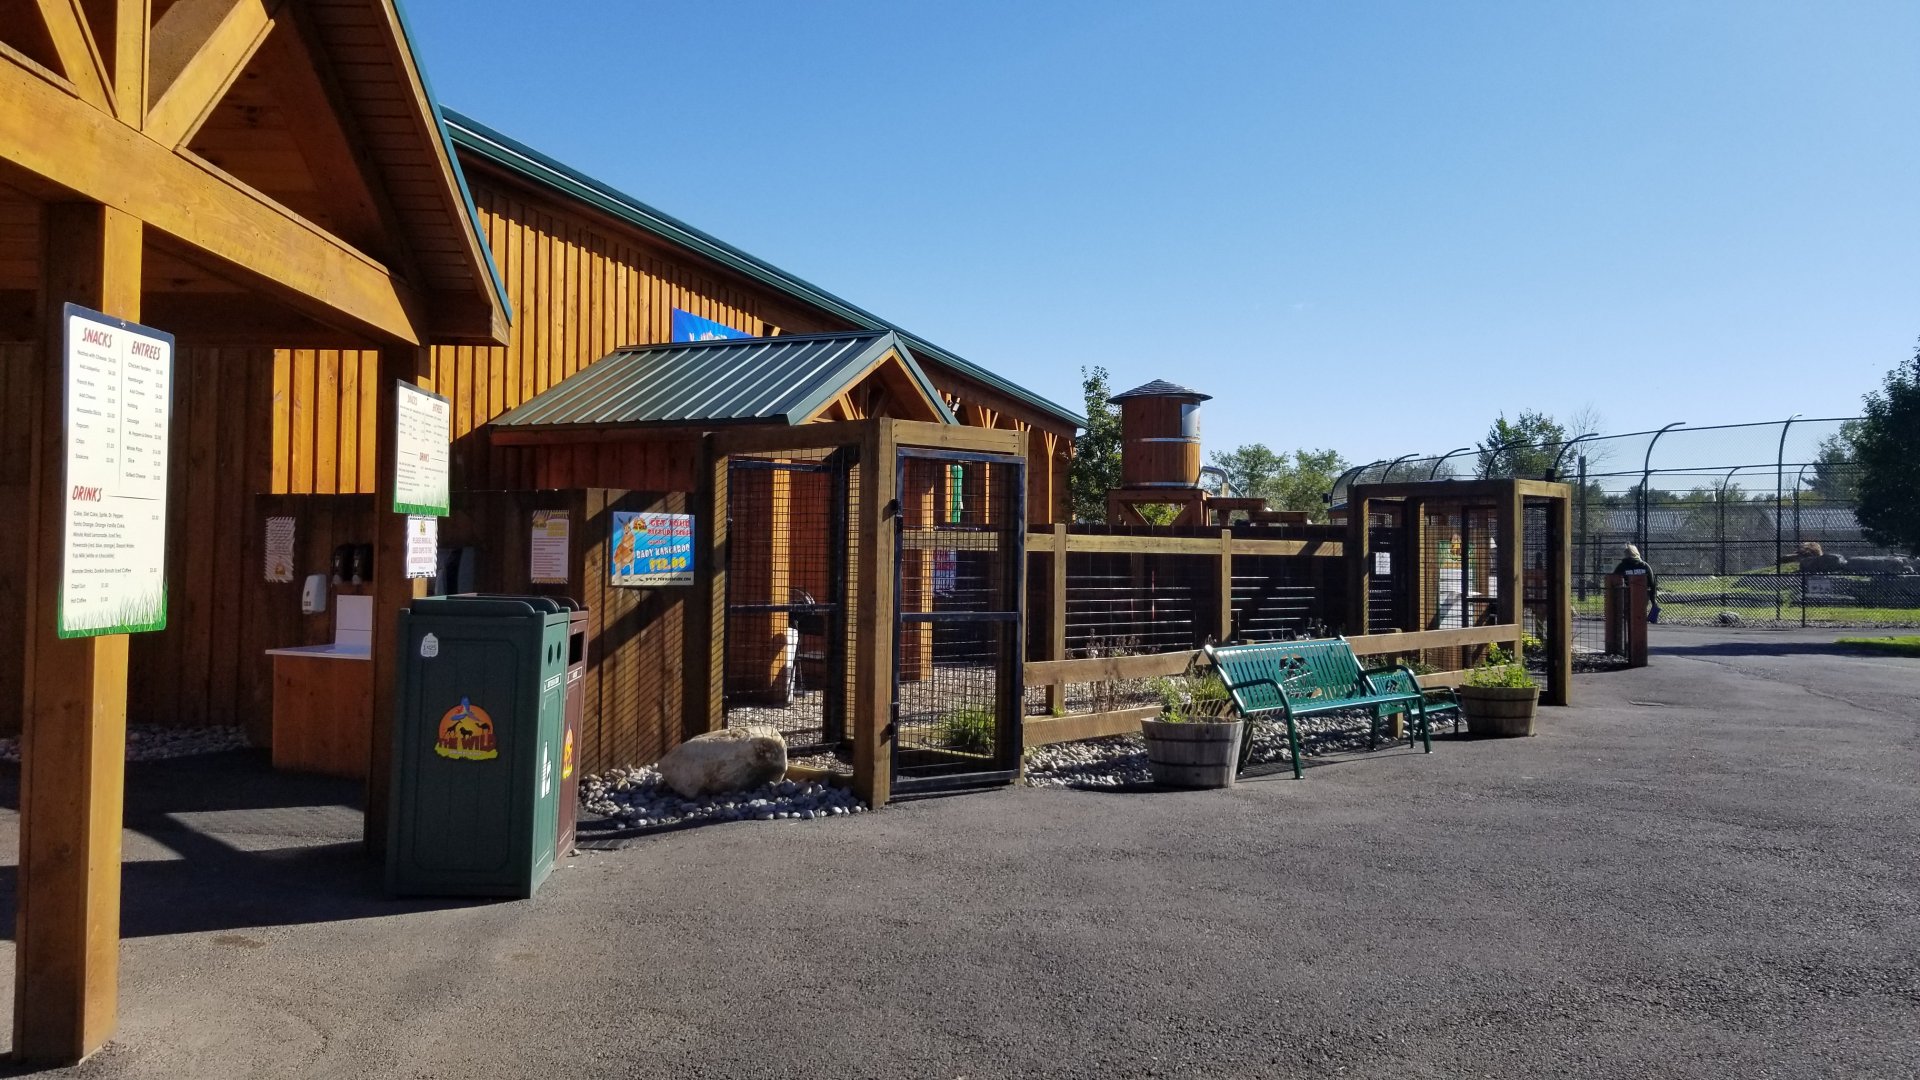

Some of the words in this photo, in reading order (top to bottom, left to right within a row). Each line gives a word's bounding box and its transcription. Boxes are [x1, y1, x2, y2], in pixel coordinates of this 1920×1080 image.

[82, 327, 112, 349] SNACKS
[131, 340, 161, 361] ENTREES
[72, 485, 102, 502] DRINKS
[649, 518, 666, 527] GET
[636, 548, 653, 559] BABY
[655, 543, 690, 556] KANGAROO
[437, 737, 458, 750] THE
[461, 733, 497, 752] WILD
